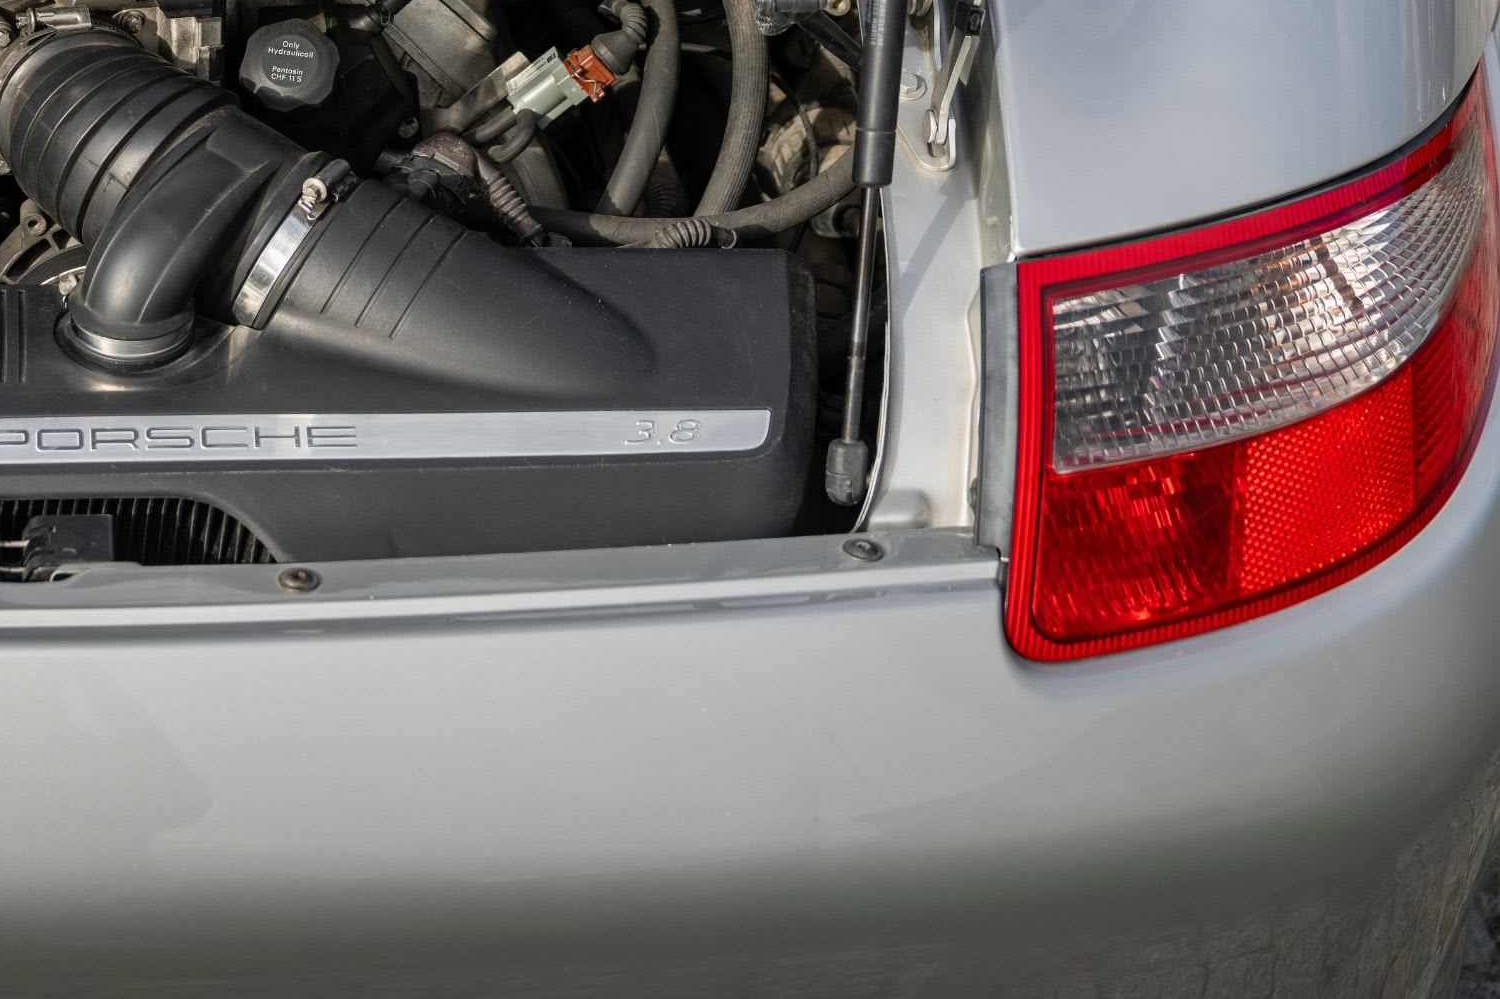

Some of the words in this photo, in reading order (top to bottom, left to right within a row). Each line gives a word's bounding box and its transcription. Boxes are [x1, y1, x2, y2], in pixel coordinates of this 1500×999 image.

[282, 40, 300, 49] Only
[268, 47, 313, 58] Hydraulicoil
[272, 66, 303, 75] Pentosin
[271, 72, 287, 81] CHF
[288, 73, 295, 82] 11
[296, 75, 302, 83] S
[624, 419, 702, 445] 3.8
